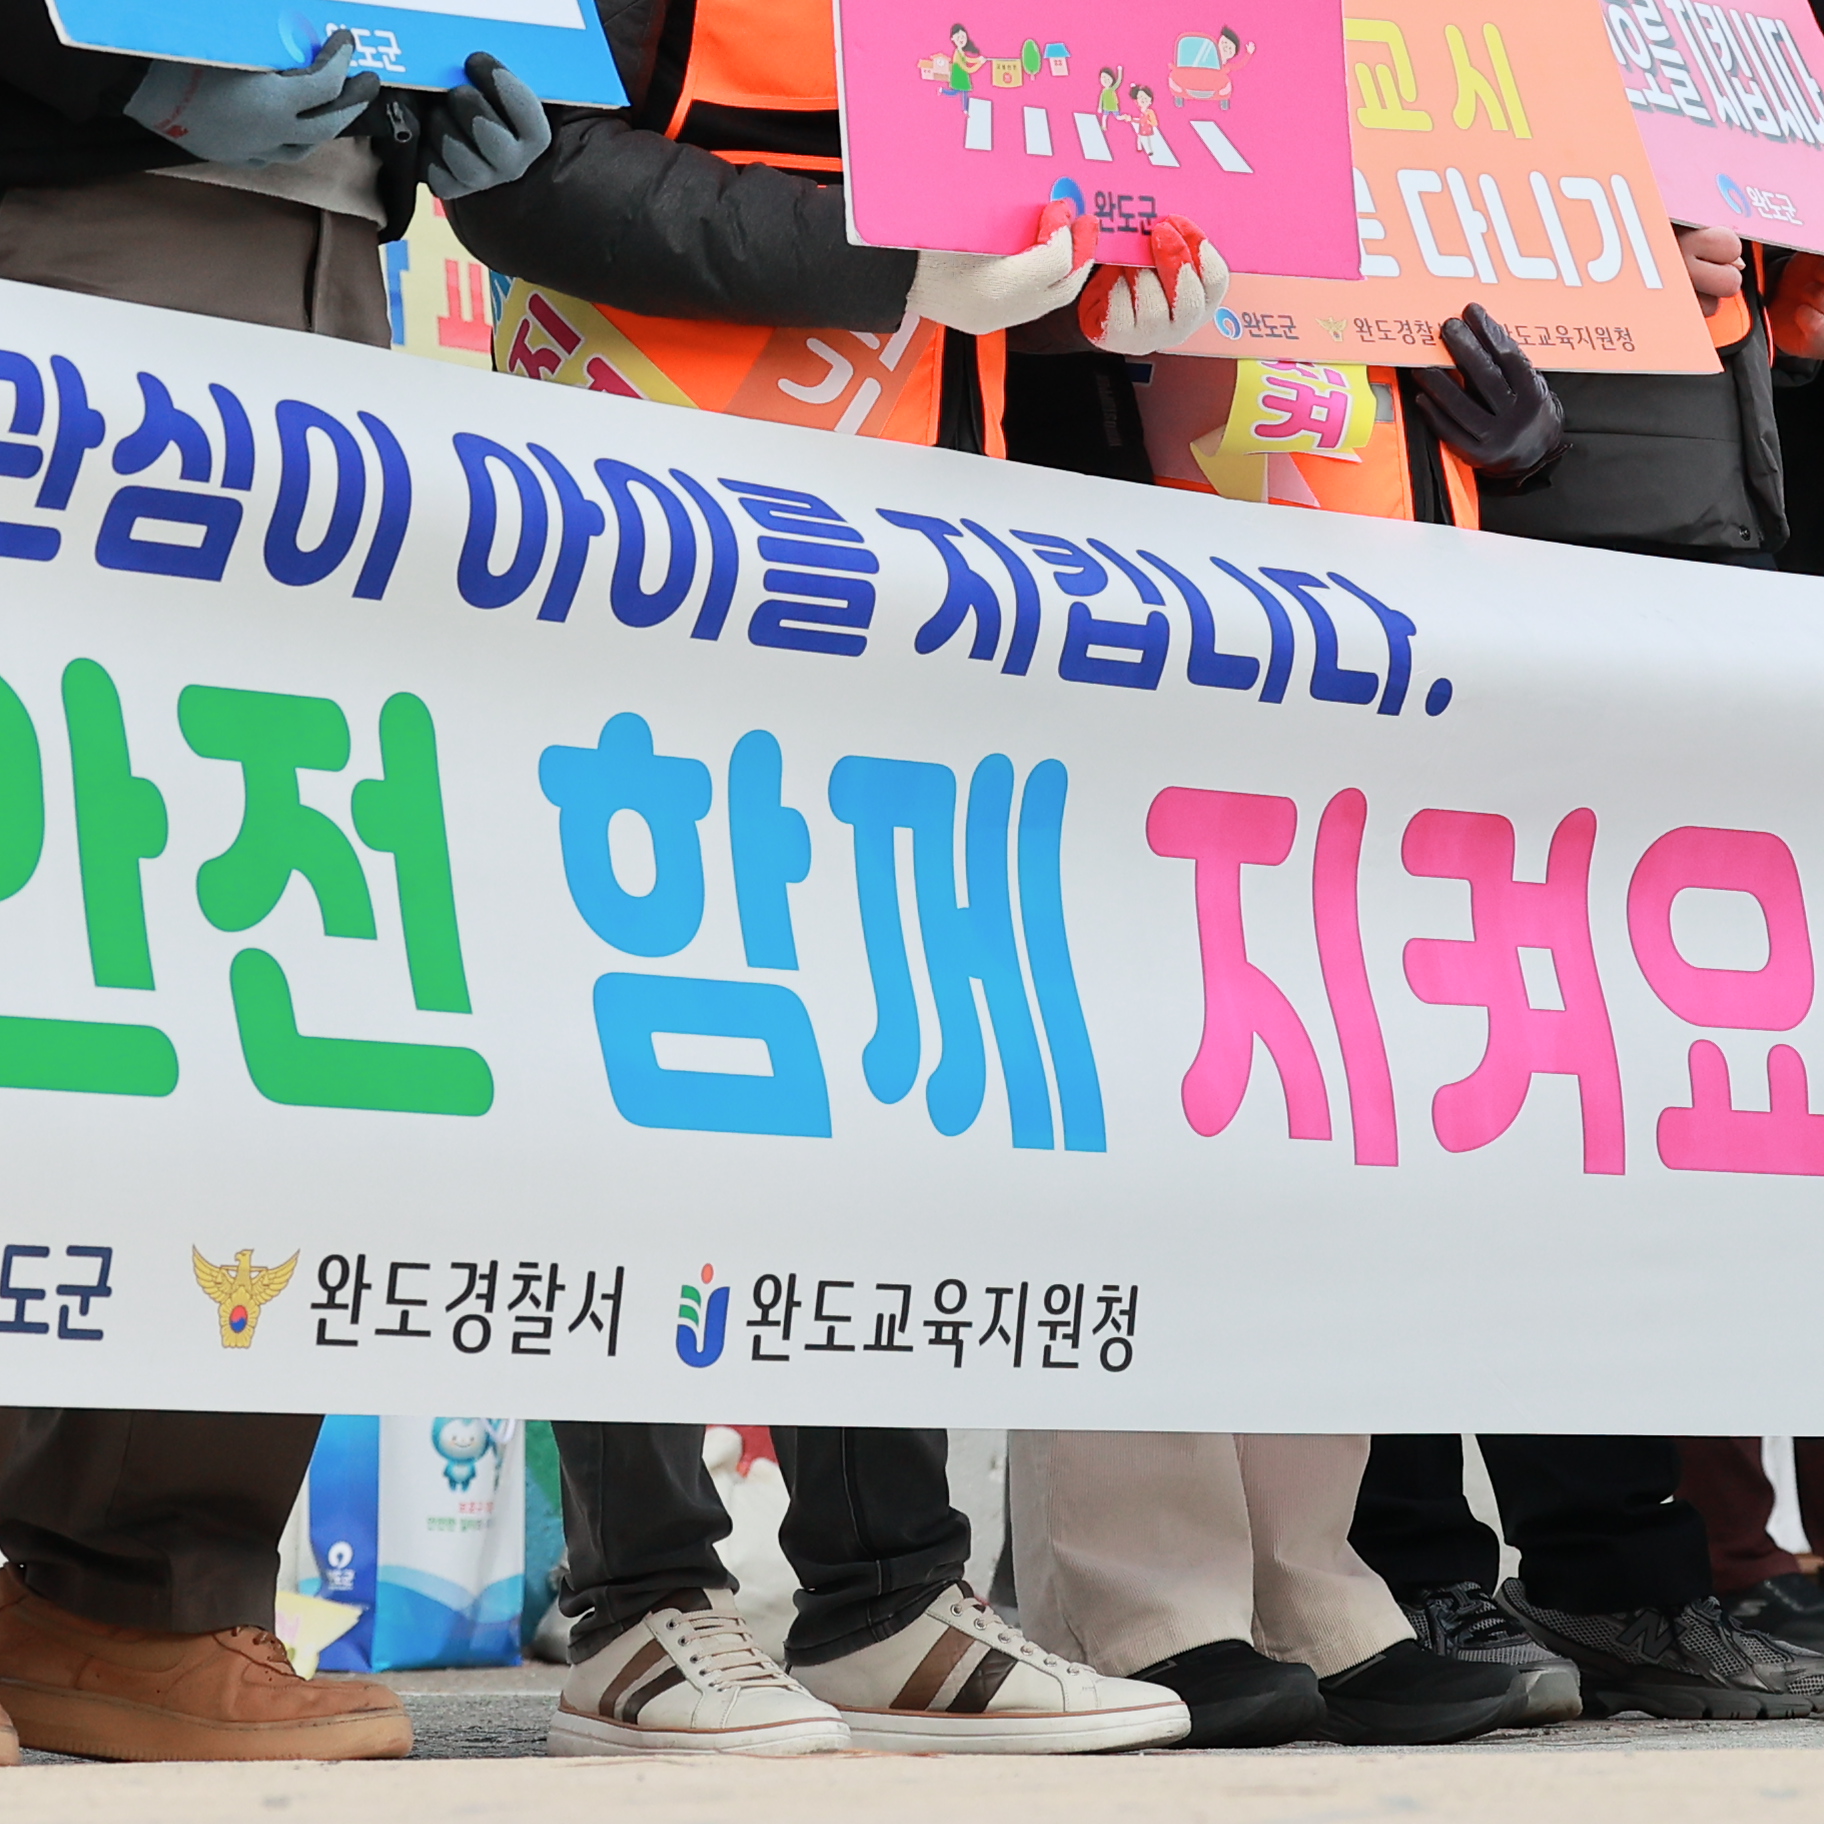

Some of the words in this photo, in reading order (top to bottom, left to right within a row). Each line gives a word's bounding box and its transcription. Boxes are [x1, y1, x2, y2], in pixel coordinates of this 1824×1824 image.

[1444, 22, 1533, 139] 시
[1094, 190, 1157, 236] 완도군
[1397, 167, 1664, 290] 다니기
[1745, 185, 1805, 226] 완도군
[1242, 311, 1299, 340] 완도군
[1352, 316, 1442, 348] 완도경찰
[1502, 323, 1636, 353] 도교육지원청
[457, 438, 882, 660] 아이를
[879, 504, 1454, 721] 지킵니다.
[537, 711, 1108, 1154] 함께
[309, 1252, 626, 1358] 완도경찰서
[742, 1271, 1142, 1374] 완도교육지원청
